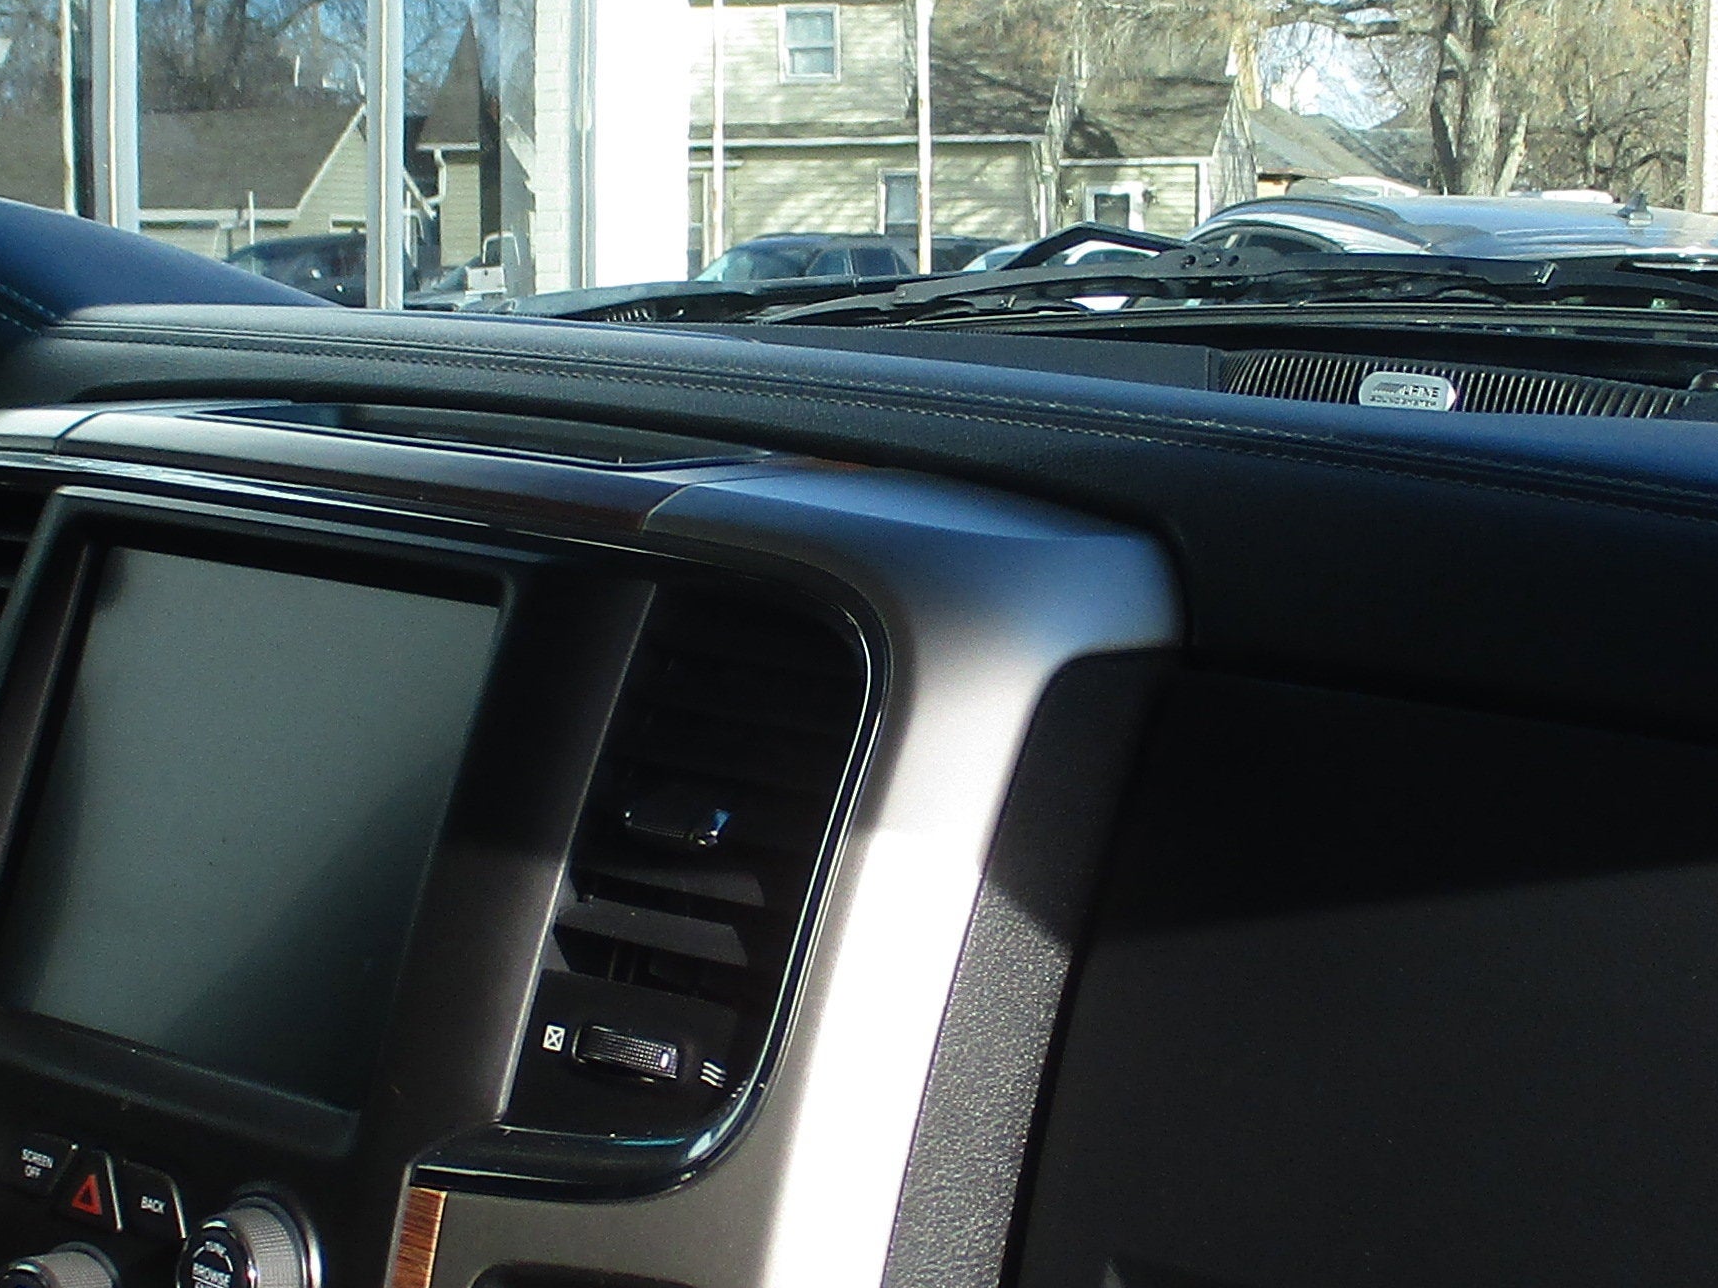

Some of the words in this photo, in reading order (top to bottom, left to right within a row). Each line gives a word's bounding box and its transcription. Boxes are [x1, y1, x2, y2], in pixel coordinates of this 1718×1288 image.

[21, 1148, 54, 1169] SCREEN
[24, 1164, 42, 1178] OFF
[140, 1195, 166, 1215] BACK
[191, 1262, 232, 1288] BROWSE
